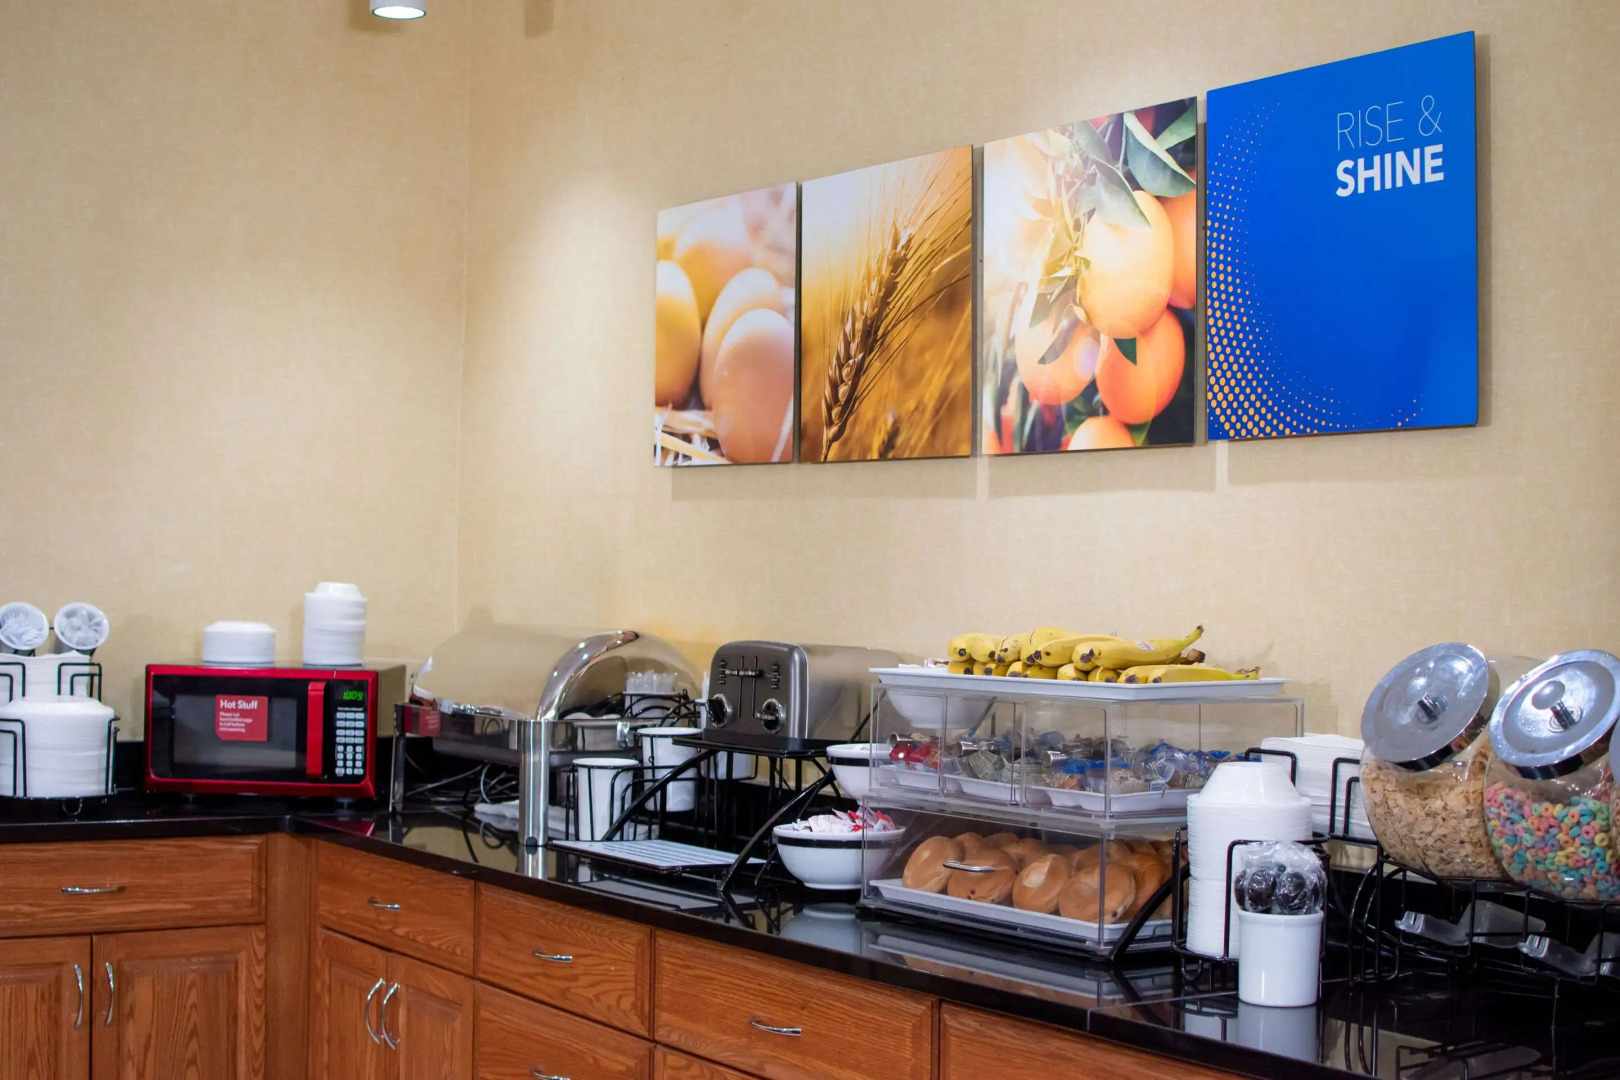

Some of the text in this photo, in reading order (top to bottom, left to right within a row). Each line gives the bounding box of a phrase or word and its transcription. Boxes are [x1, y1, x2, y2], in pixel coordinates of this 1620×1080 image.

[1337, 94, 1443, 152] RISE &
[1335, 143, 1445, 198] SHINE
[220, 699, 258, 710] Hot Stuff
